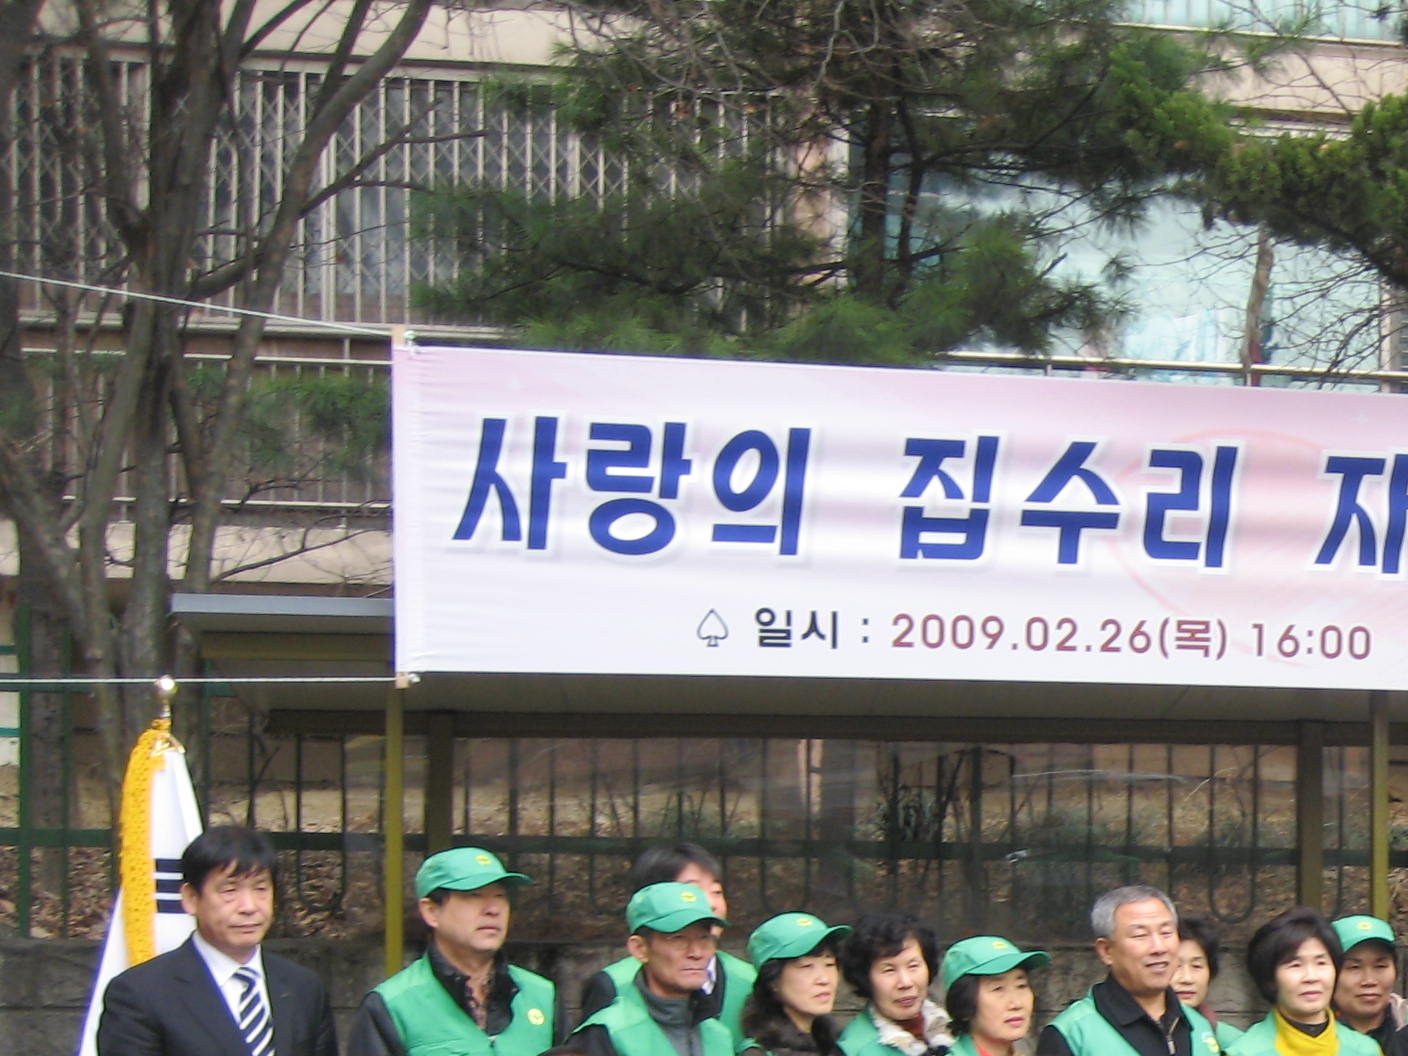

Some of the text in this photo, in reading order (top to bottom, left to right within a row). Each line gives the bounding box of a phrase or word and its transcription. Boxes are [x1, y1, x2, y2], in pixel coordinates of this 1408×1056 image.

[452, 415, 812, 557] 사랑의
[899, 434, 1239, 569] 집수리
[755, 606, 840, 650] 일시
[891, 612, 1229, 661] 2009.02.26(목)
[1251, 622, 1373, 661] 16:00
